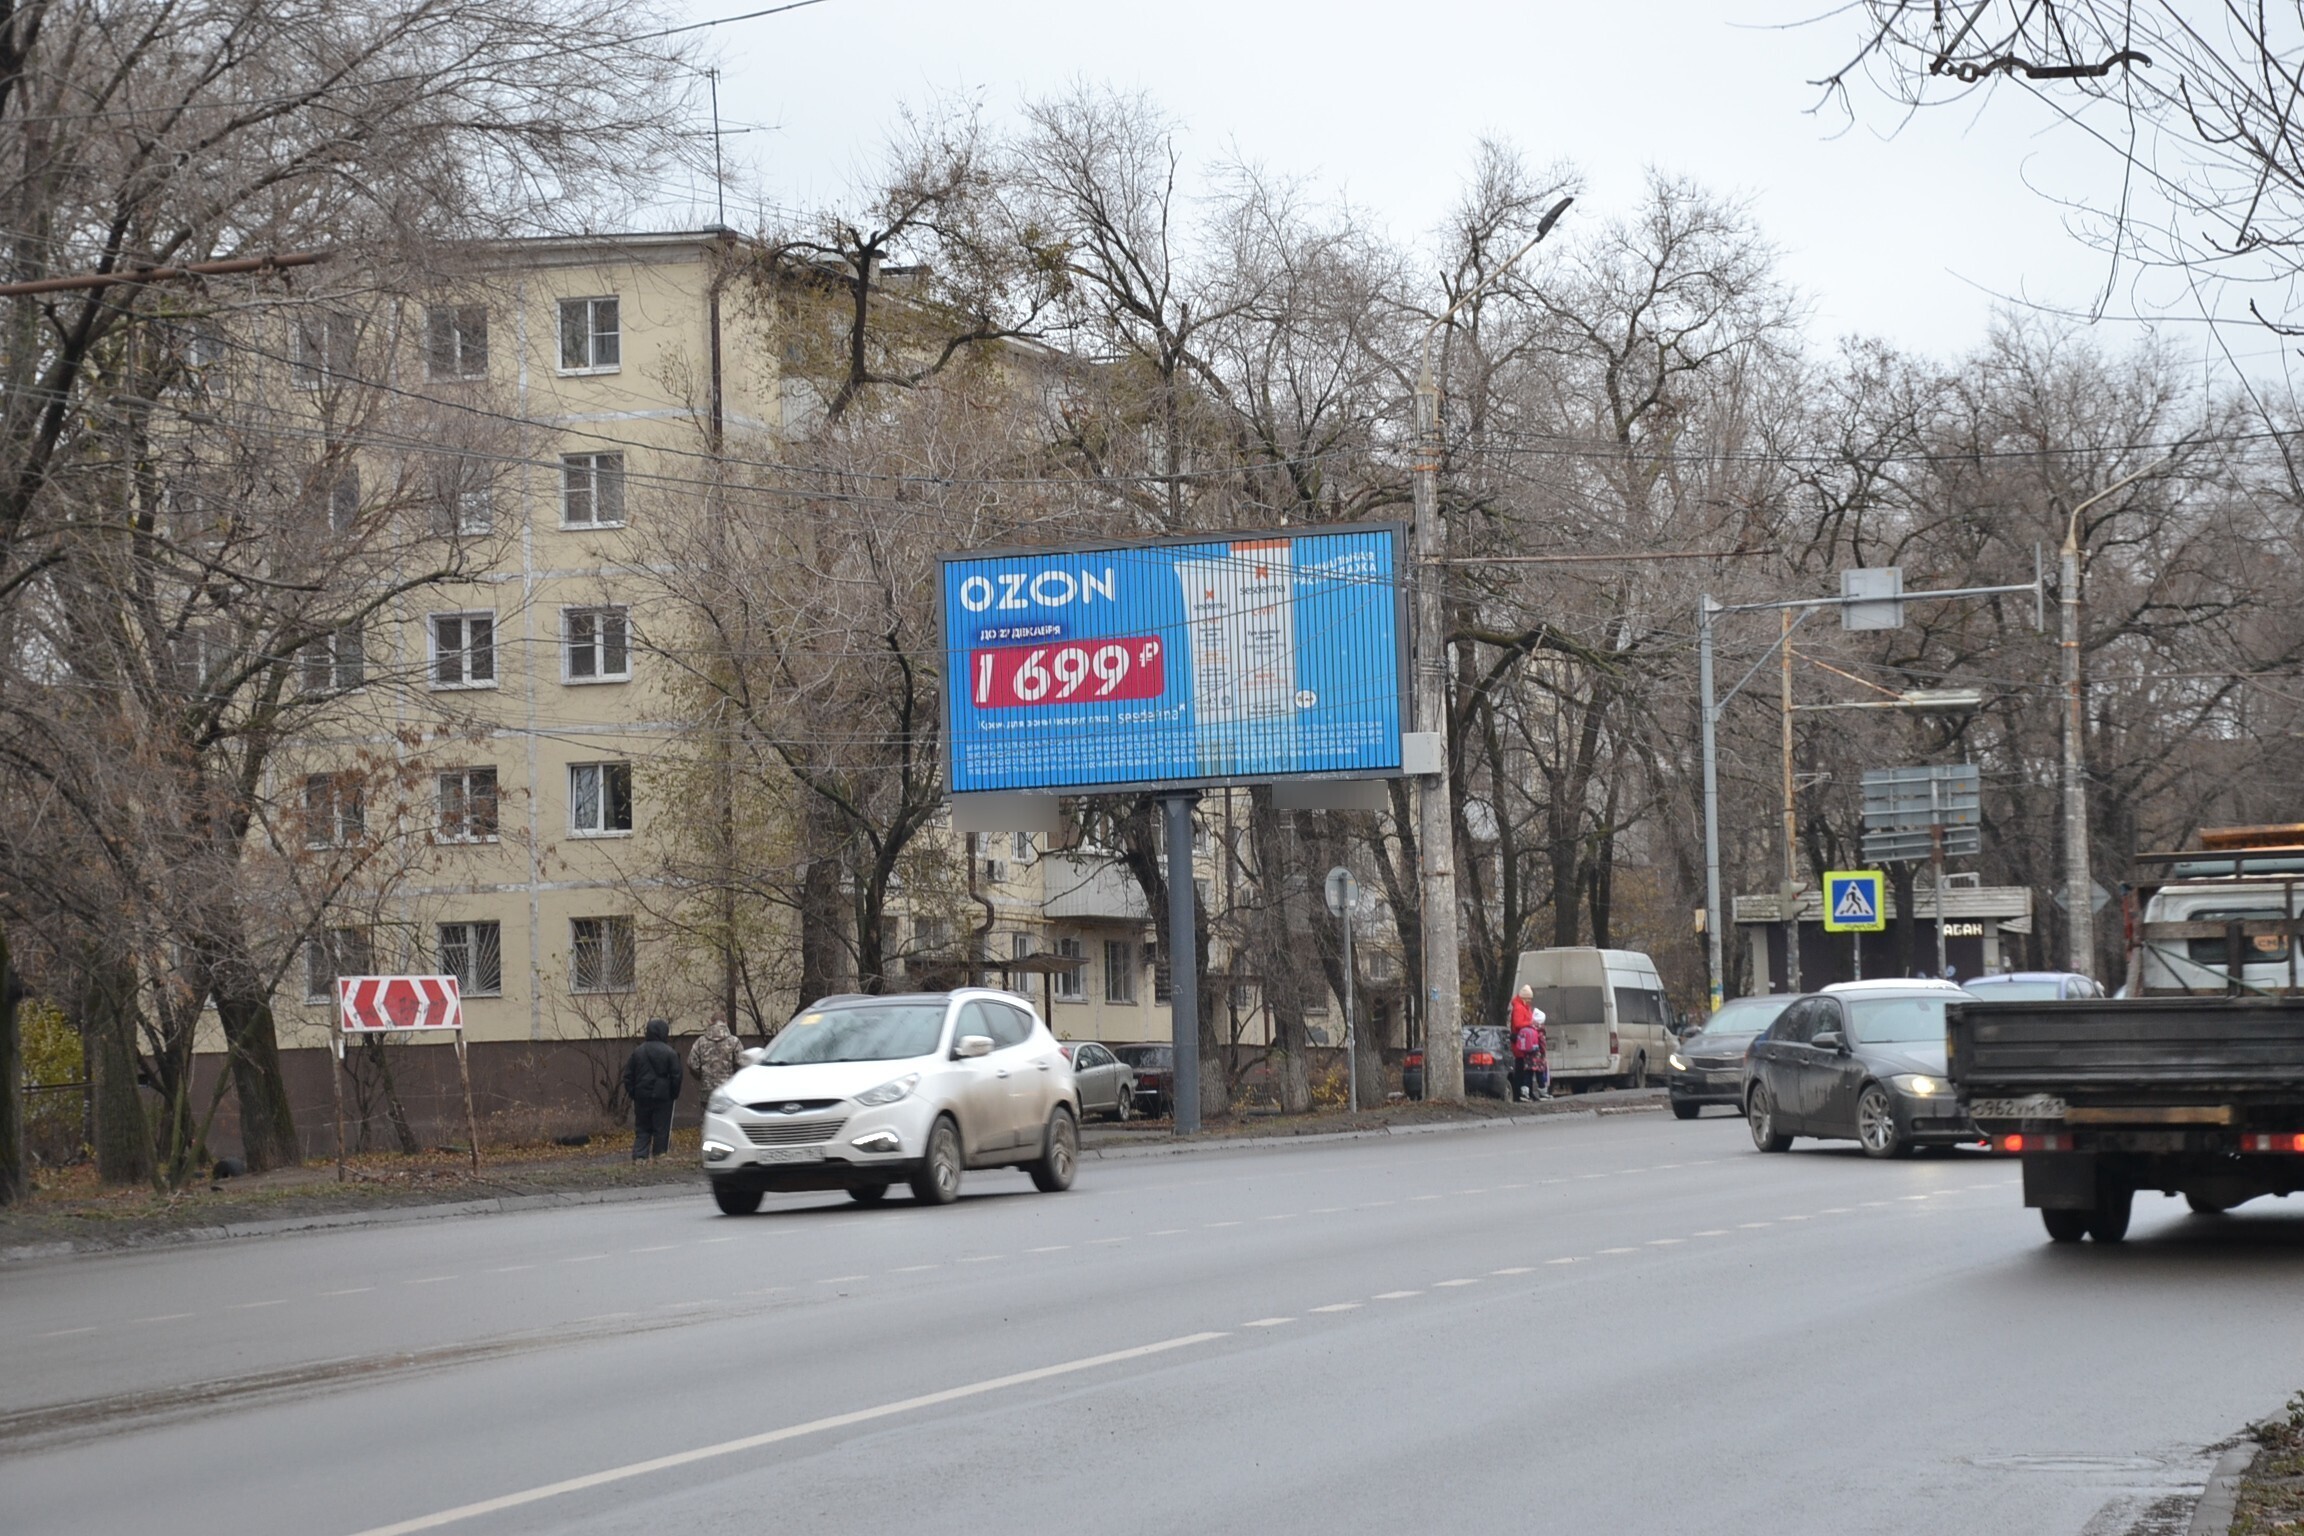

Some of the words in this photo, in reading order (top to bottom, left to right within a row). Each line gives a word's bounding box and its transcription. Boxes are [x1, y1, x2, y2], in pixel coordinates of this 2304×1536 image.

[960, 567, 1116, 612] OZON
[1239, 584, 1286, 595] sesderma
[1193, 602, 1227, 611] sesderma
[980, 630, 997, 640] ДО
[1011, 625, 1061, 638] ДЕКАБРЯ
[975, 653, 994, 703] 1
[1012, 644, 1131, 701] 699
[1117, 708, 1179, 724] sesderma
[1935, 923, 1983, 936] АБАК
